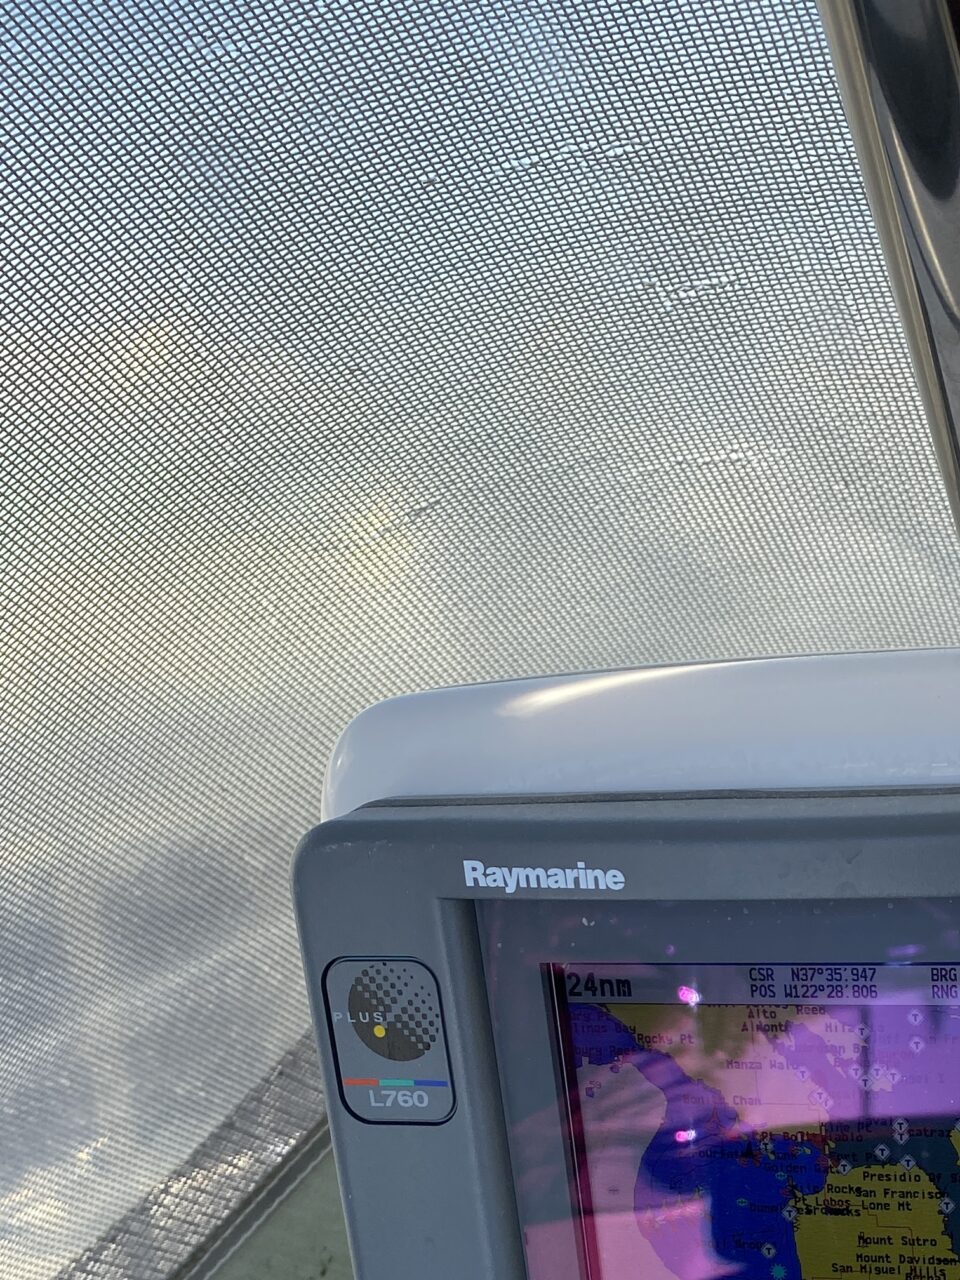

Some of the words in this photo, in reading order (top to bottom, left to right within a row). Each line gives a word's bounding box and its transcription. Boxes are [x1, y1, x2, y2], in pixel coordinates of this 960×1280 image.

[463, 860, 625, 893] Raymarine
[748, 967, 775, 981] CSR
[930, 968, 957, 983] BRG
[566, 972, 633, 997] 24nm
[750, 984, 776, 998] POS
[931, 984, 958, 999] RNG
[334, 1011, 384, 1023] PLUS
[747, 1009, 777, 1019] Alto
[637, 1033, 673, 1044] Rocky
[680, 1033, 695, 1044] Pt
[368, 1089, 429, 1108] L760
[862, 1171, 921, 1183] Presidio
[855, 1186, 877, 1198] San
[883, 1188, 947, 1200] Francisco
[815, 1197, 852, 1208] Lobos
[862, 1200, 891, 1211] Lone
[898, 1200, 912, 1212] Mt
[857, 1234, 894, 1246] Mount
[901, 1236, 937, 1247] Sutro
[856, 1253, 892, 1264] Mount
[898, 1254, 958, 1266] Davidson
[831, 1263, 853, 1273] San
[860, 1264, 901, 1275] Miguel
